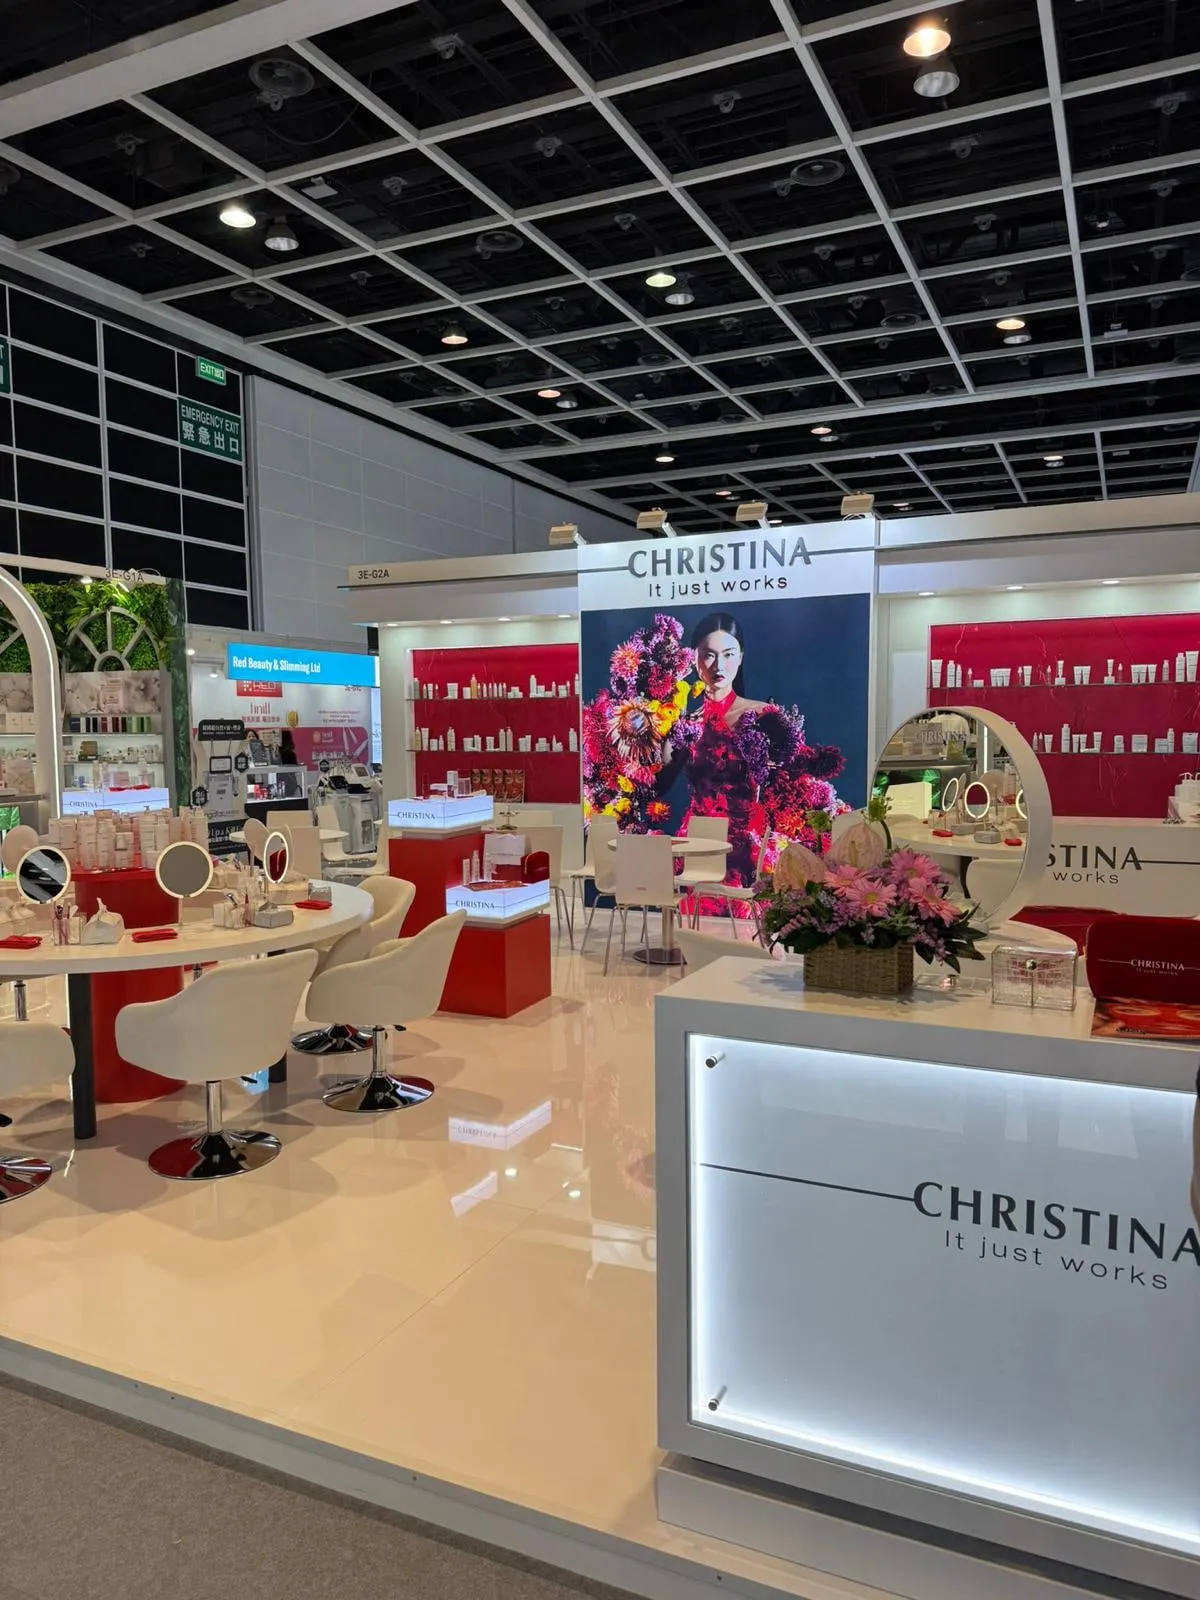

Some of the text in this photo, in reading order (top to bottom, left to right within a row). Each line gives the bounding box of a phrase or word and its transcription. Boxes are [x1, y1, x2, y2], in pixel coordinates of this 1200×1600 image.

[181, 405, 239, 435] EMERGENCY EXIT
[182, 421, 239, 454] 緊急出口
[628, 537, 811, 578] CHRISTINA
[105, 567, 145, 583] 3E-G1A
[358, 569, 390, 580] 3E-G2A
[649, 575, 788, 600] It just works
[233, 656, 321, 676] Red Beauty & Slimming Ltd
[397, 811, 436, 821] CHRISTINA
[1053, 871, 1120, 885] works
[455, 900, 495, 910] CHRISTINA
[1130, 958, 1185, 971] CHRISTINA
[914, 1181, 1200, 1266] CHRISTINA
[945, 1230, 1168, 1290] It just works
